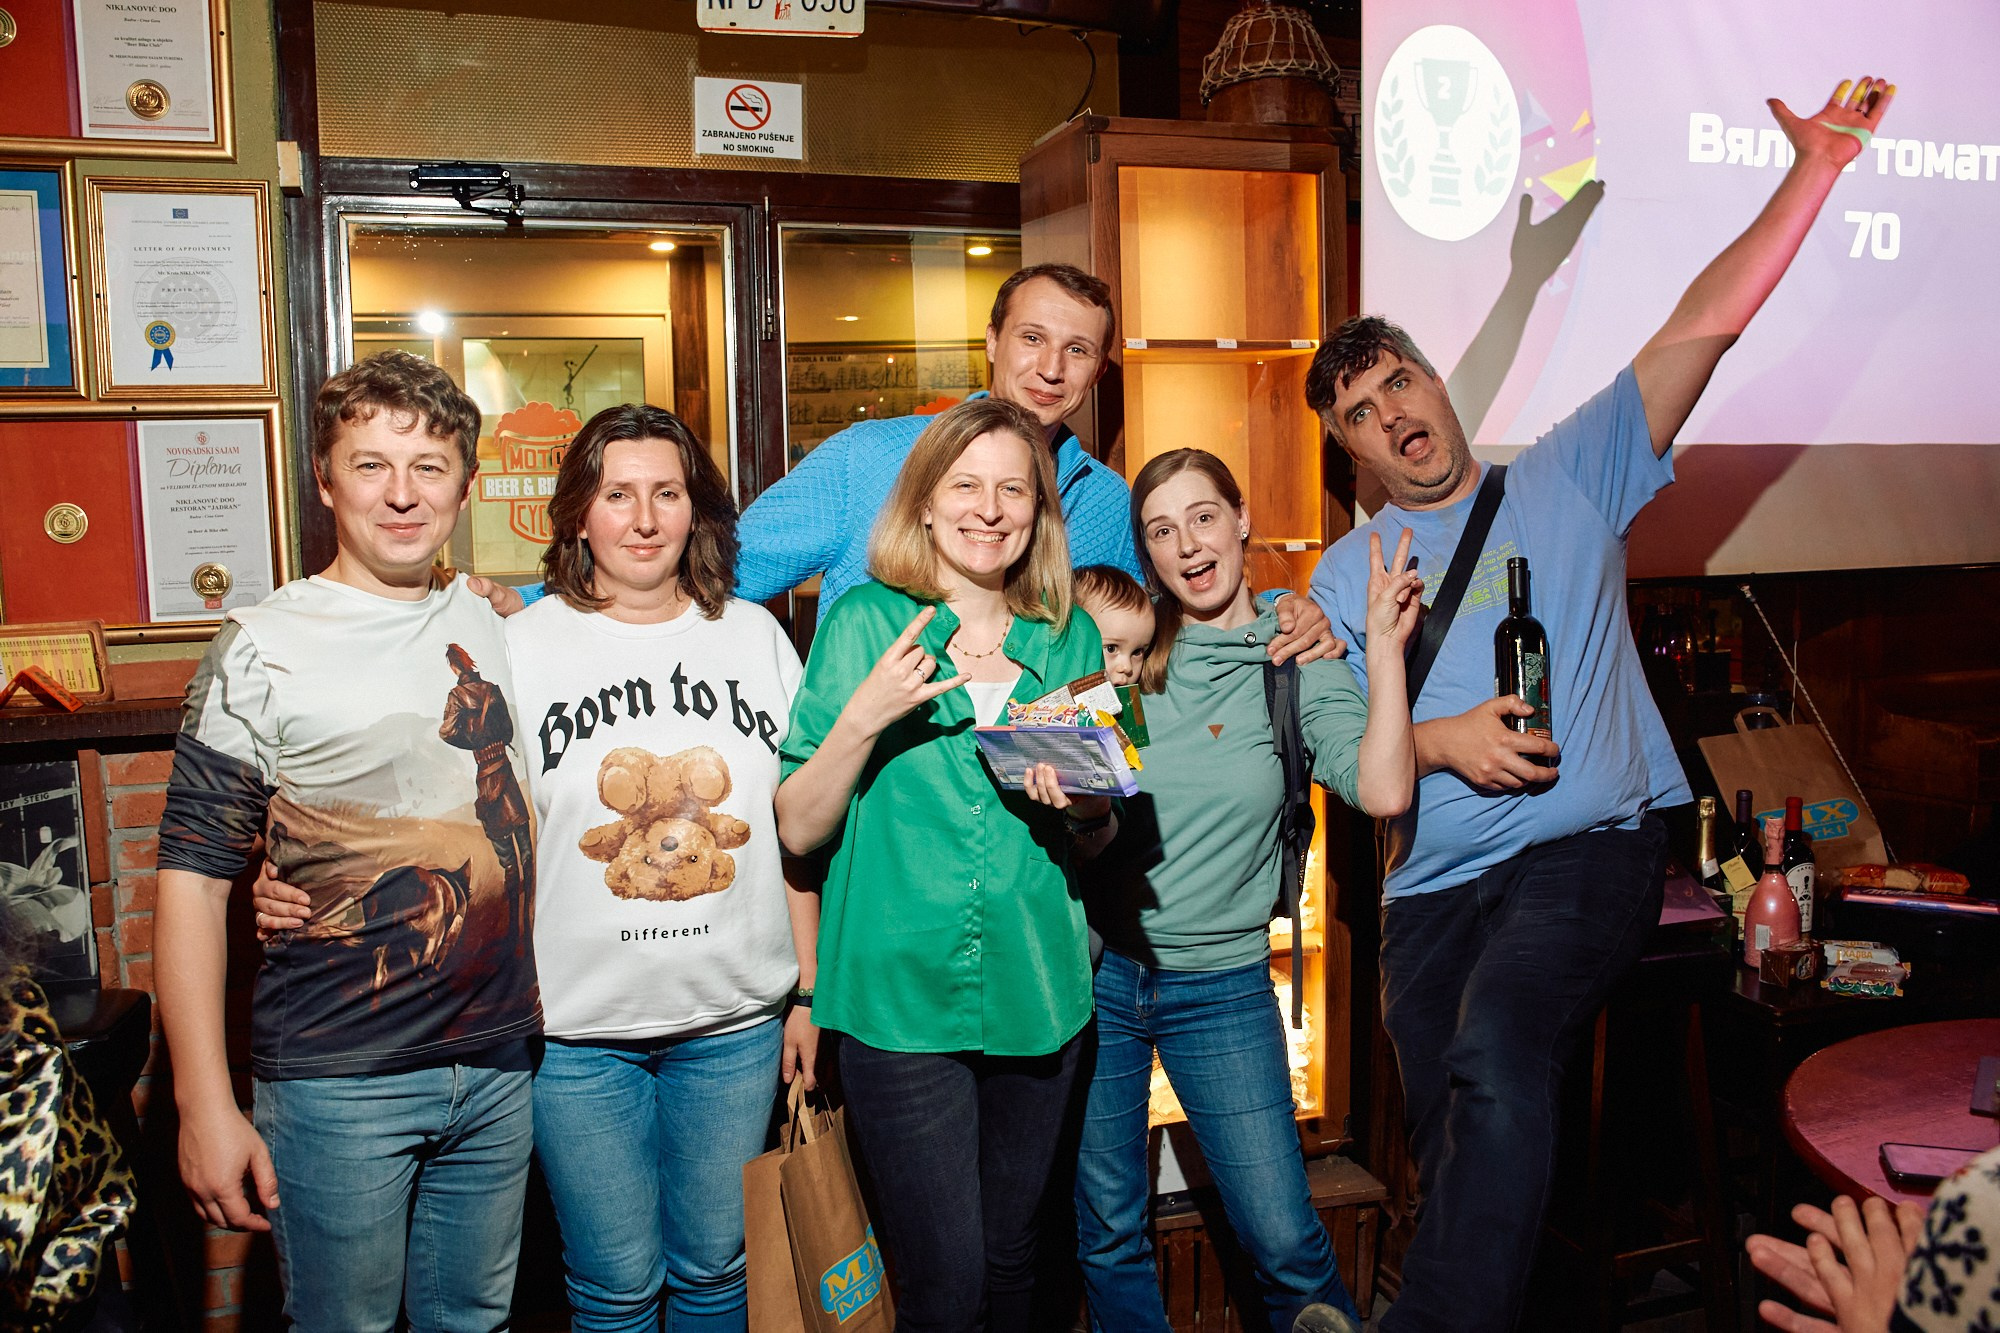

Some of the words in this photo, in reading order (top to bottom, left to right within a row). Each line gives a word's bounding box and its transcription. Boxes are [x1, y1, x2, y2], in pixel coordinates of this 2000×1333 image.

[105, 3, 157, 13] NIKLANOVIĆ
[1437, 76, 1452, 100] 2
[702, 129, 757, 140] ZABRANJENO
[758, 132, 795, 143] PUŠENJE
[723, 143, 735, 152] NO
[737, 144, 775, 154] SMOKING
[1688, 112, 1857, 173] Вял
[1870, 137, 2000, 182] томат
[1844, 210, 1901, 261] 70
[166, 446, 214, 455] NOVOSADSKI
[215, 446, 240, 455] SAJAM
[509, 446, 568, 469] MOTO
[166, 456, 242, 482] Diploma
[485, 478, 520, 497] BEER
[523, 477, 535, 496] &
[170, 505, 207, 513] RESTORAN
[175, 496, 219, 505] NIKLANOVIĆ
[538, 677, 657, 777] Born
[670, 661, 718, 721] to
[725, 679, 779, 756] be
[24, 792, 50, 805] STEIG
[620, 923, 711, 942] Different
